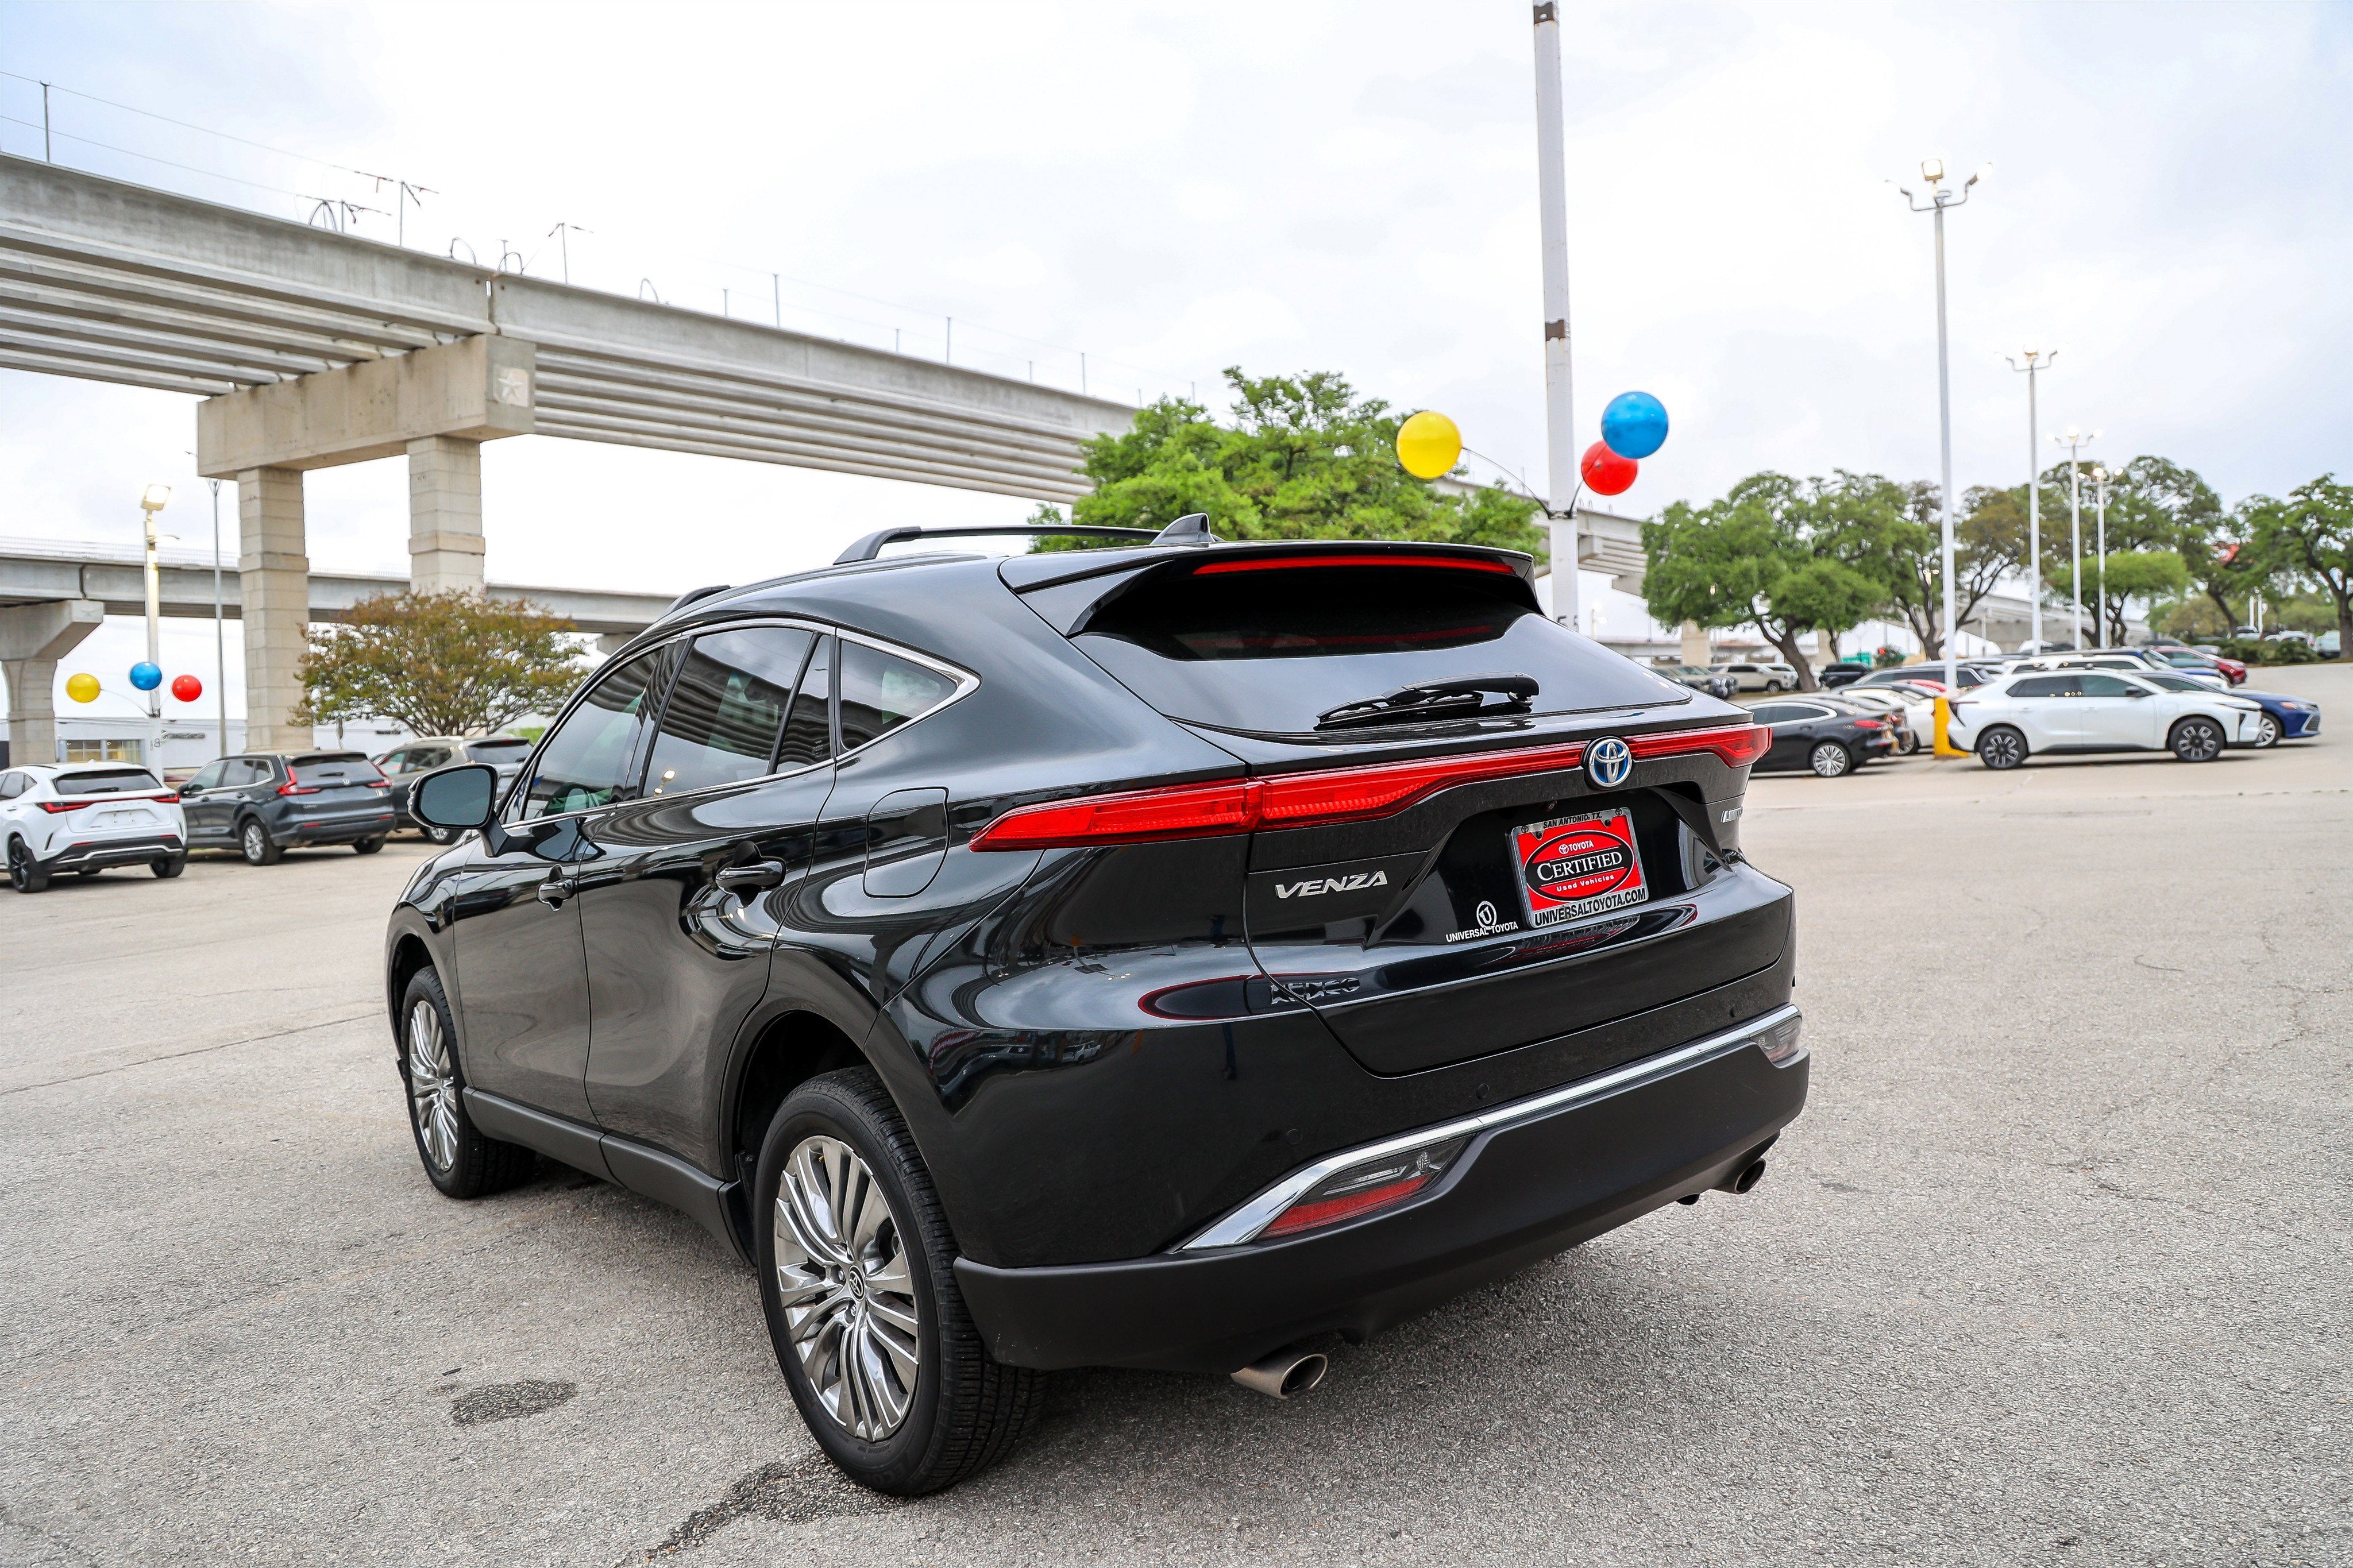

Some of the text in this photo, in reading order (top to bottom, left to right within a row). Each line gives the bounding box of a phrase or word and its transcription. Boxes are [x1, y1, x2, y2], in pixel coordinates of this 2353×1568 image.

[1543, 820, 1557, 829] SAN
[1568, 840, 1594, 852] TOYOTA
[1537, 851, 1622, 881] CERTIFIED
[1275, 870, 1388, 899] VENZA
[1556, 874, 1614, 892] Used Vehicles
[1534, 888, 1646, 926] UNIVERSALTOYOTA.COM
[1445, 921, 1518, 943] UNIVERSAL TOYOTA
